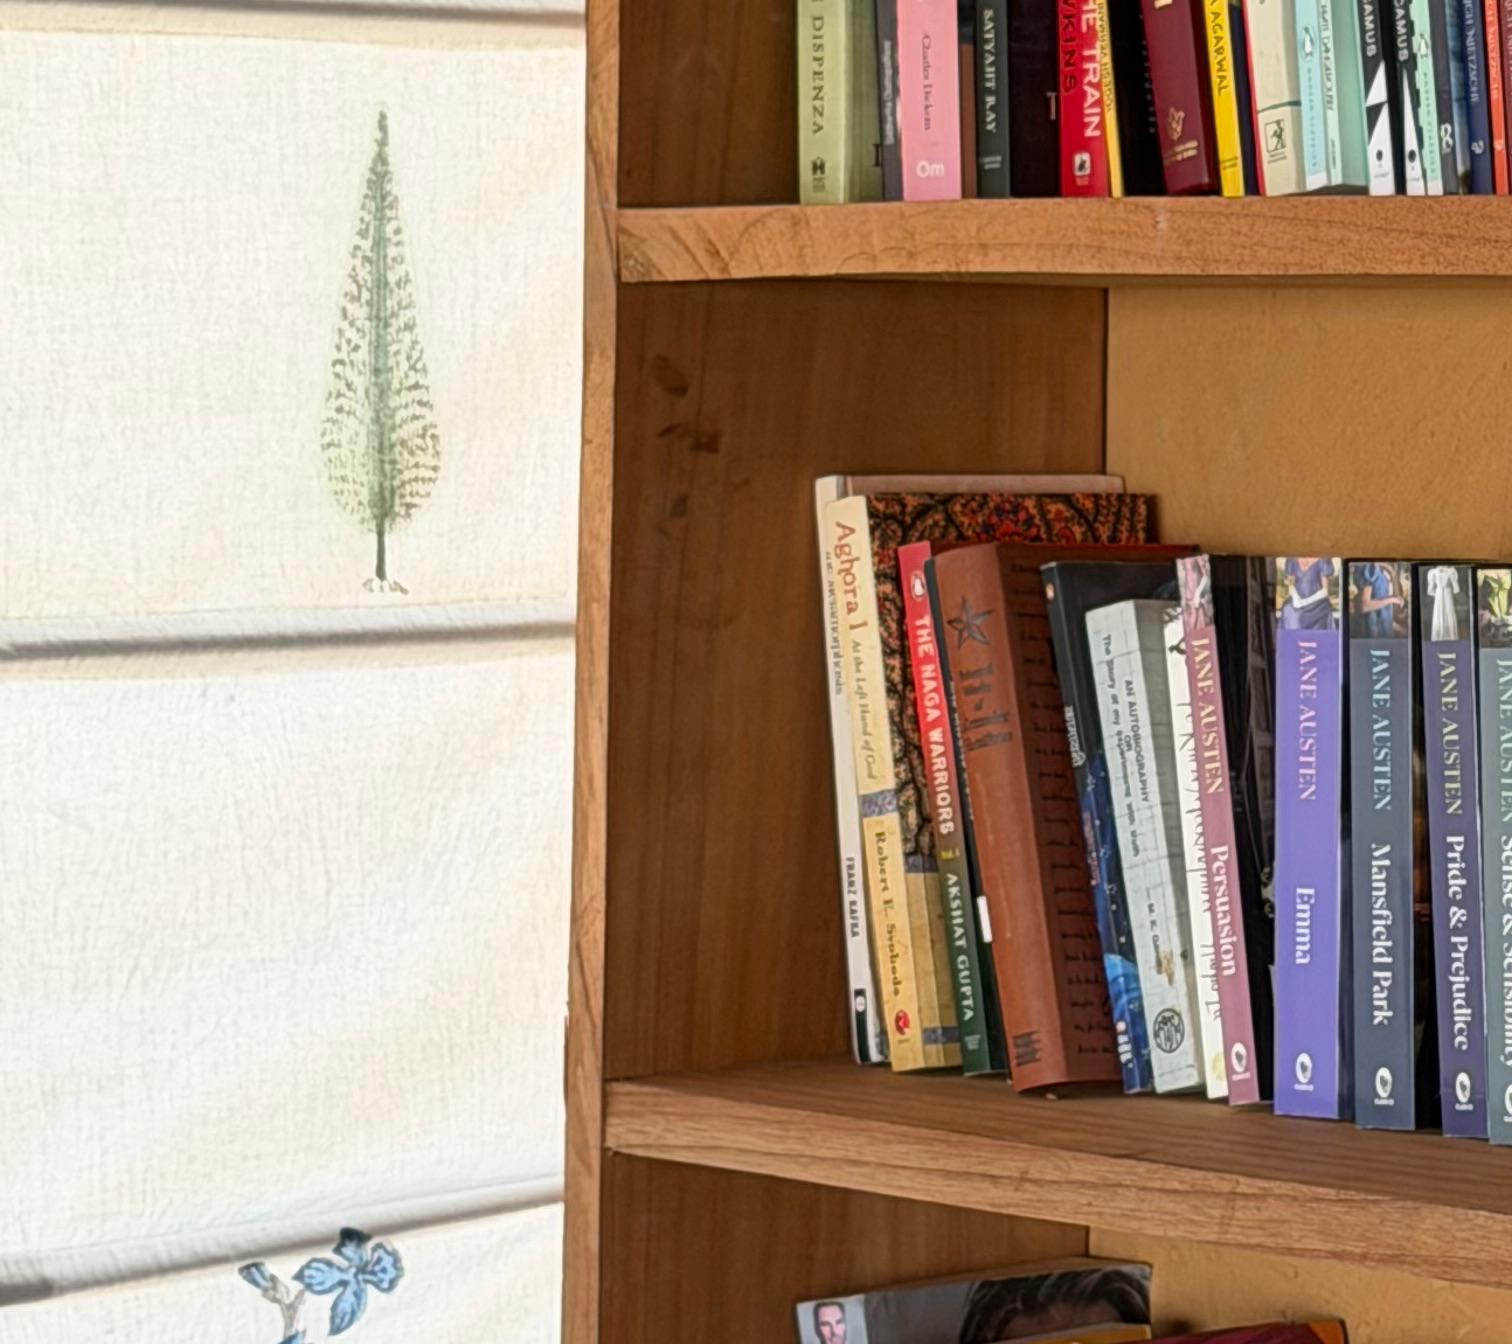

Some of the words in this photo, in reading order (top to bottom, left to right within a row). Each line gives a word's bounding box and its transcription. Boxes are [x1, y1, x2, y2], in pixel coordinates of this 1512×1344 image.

[1083, 43, 1102, 137] TRAIN
[834, 521, 861, 615] Aghora
[914, 614, 932, 656] THE
[1191, 637, 1216, 694] JANE
[1298, 640, 1317, 698] JANE
[920, 663, 939, 722] NAGA
[927, 726, 956, 835] WARRIORS
[1199, 702, 1224, 795] AUSTEN
[1299, 703, 1316, 801] AUSTEN
[945, 872, 967, 948] AKSHAT
[956, 955, 974, 1022] GUPTA
[1210, 845, 1238, 976] Persuasion
[1295, 887, 1316, 965] Emma
[1370, 843, 1393, 963] Mansfield
[1372, 971, 1394, 1026] Park
